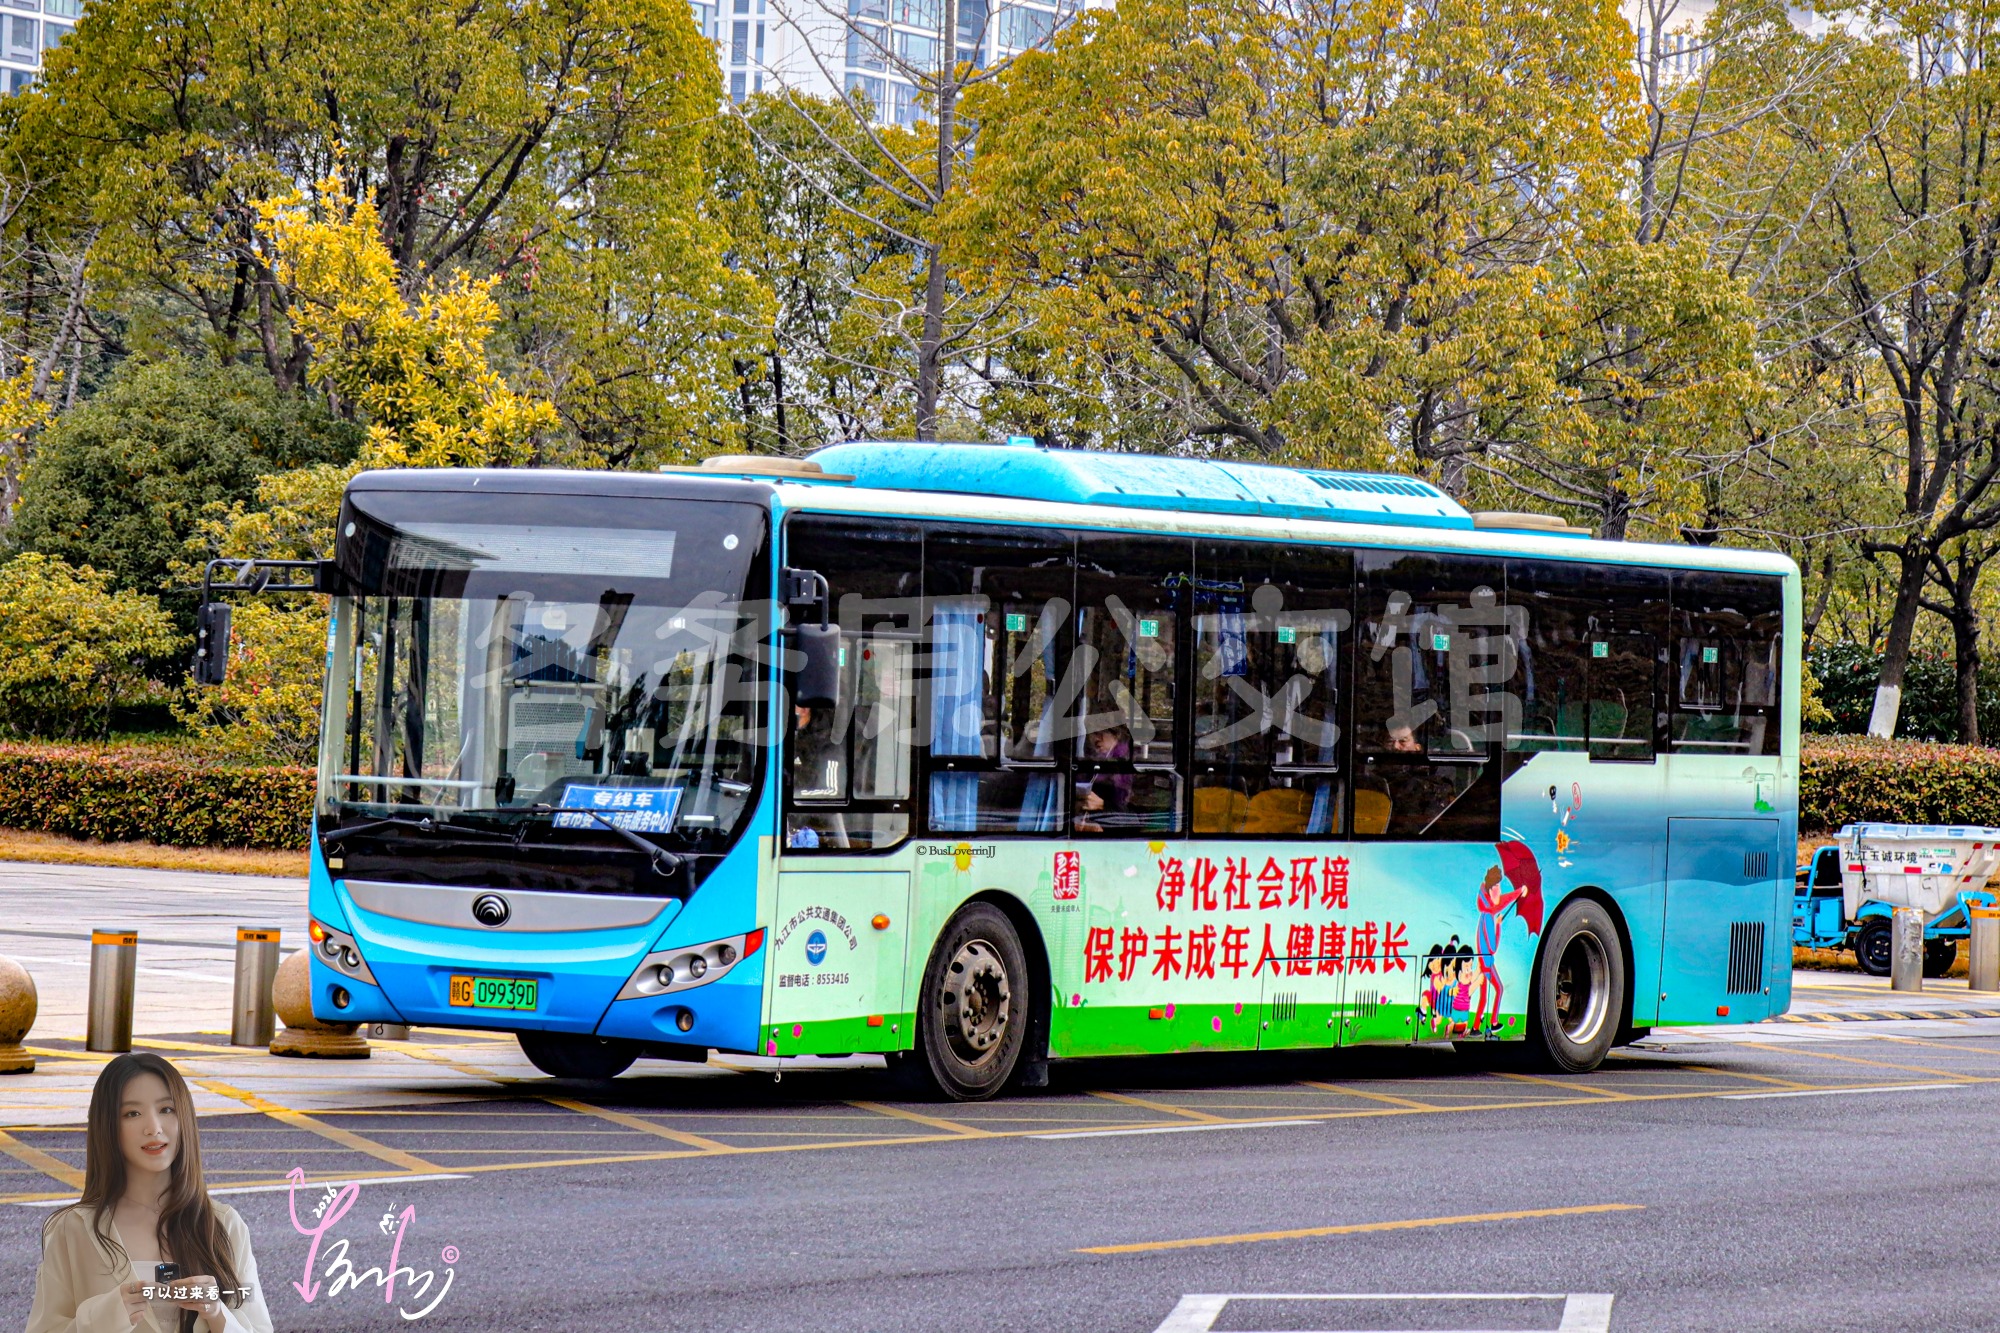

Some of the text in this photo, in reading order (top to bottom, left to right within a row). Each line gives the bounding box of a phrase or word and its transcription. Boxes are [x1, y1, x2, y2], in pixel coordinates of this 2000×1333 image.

[593, 791, 654, 808] 专线车
[1156, 855, 1350, 912] 净化社会环境
[775, 905, 858, 951] 九江市公共交通集团公司
[1083, 920, 1409, 984] 保护未成年人健康成长
